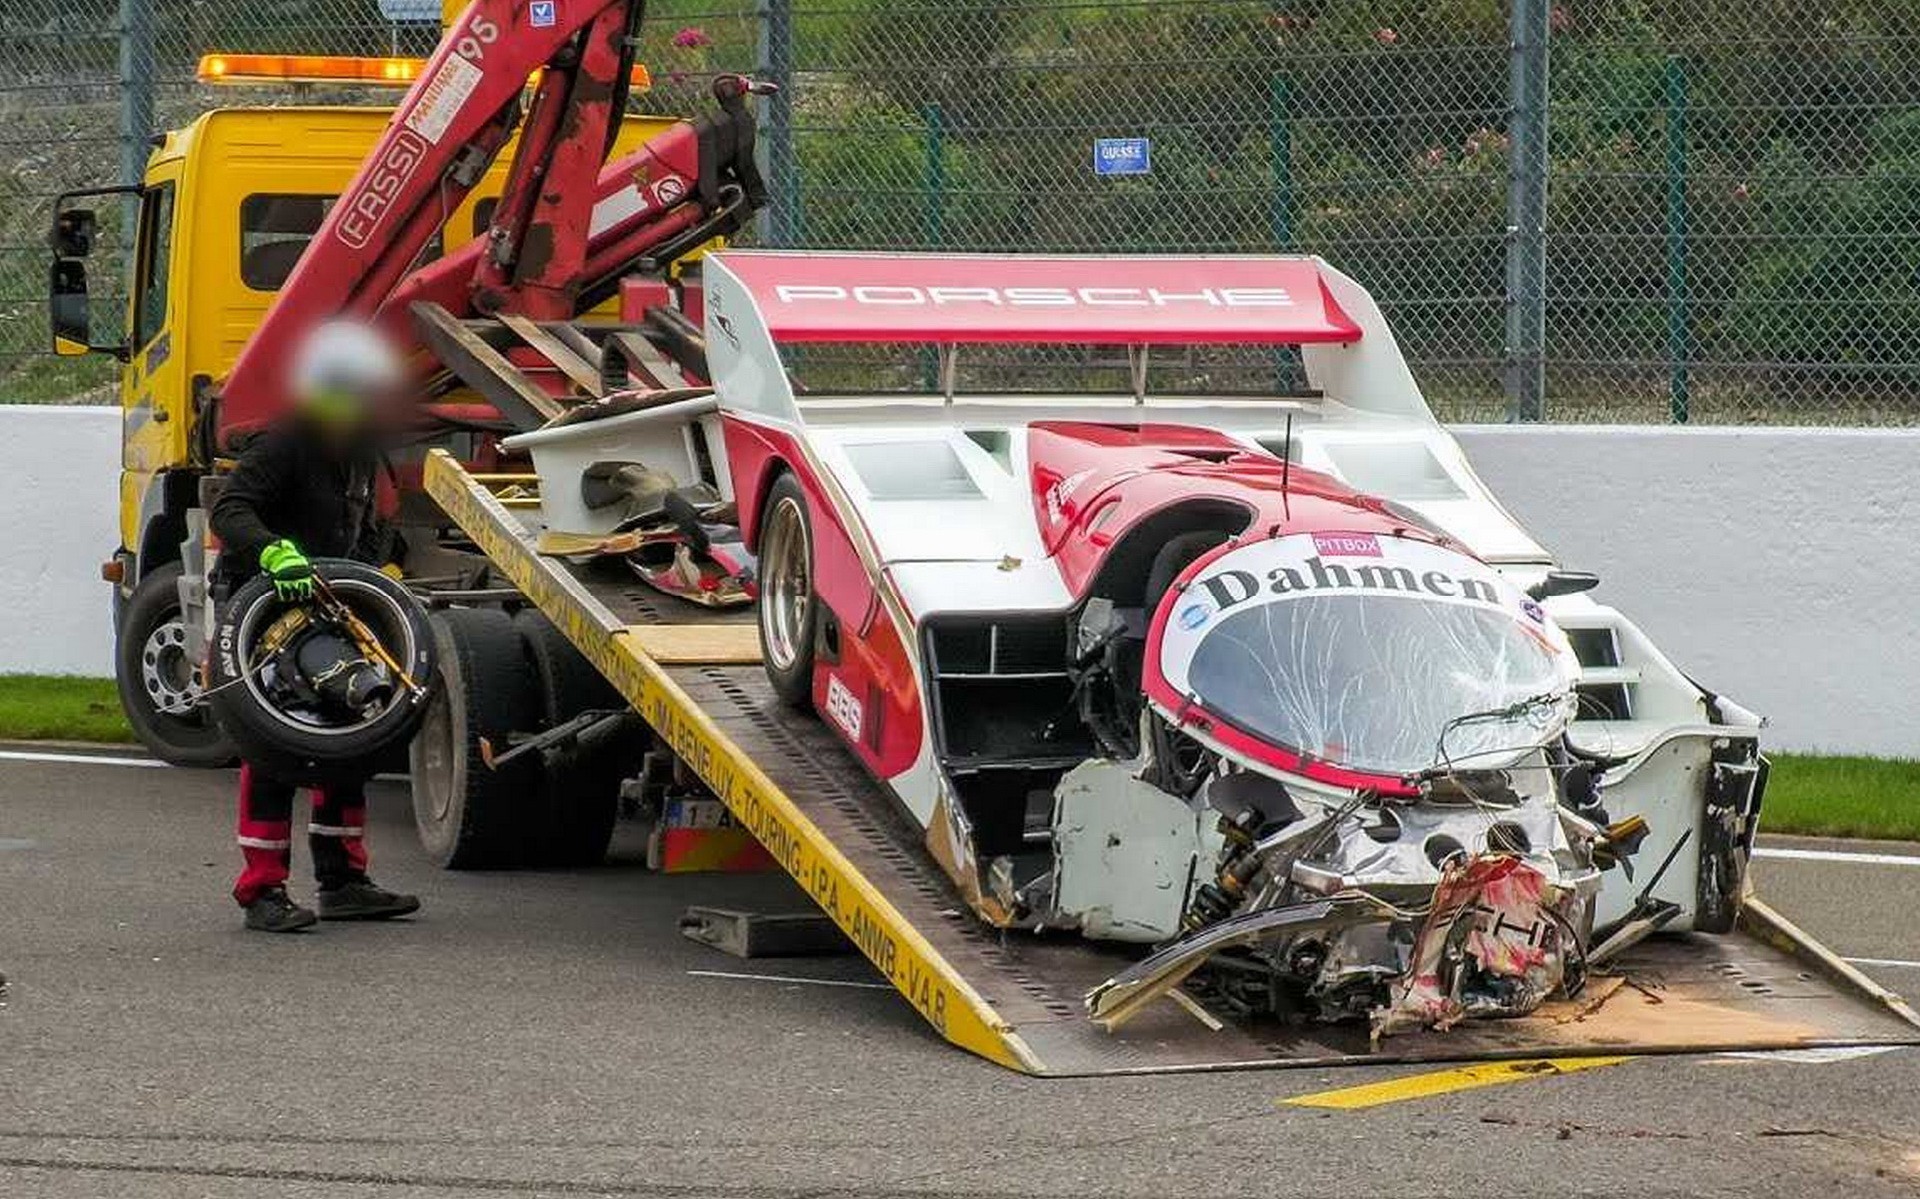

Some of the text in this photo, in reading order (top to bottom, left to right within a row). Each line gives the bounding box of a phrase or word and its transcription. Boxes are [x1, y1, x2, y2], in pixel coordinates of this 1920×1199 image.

[343, 134, 422, 241] FASSI
[774, 285, 1295, 307] PORSCHE
[1315, 538, 1378, 552] PITBOX
[1200, 556, 1499, 611] Dahmen
[220, 624, 238, 677] AVON
[826, 675, 861, 741] BBS
[745, 788, 801, 880] TOURING
[853, 906, 895, 978] ANWB
